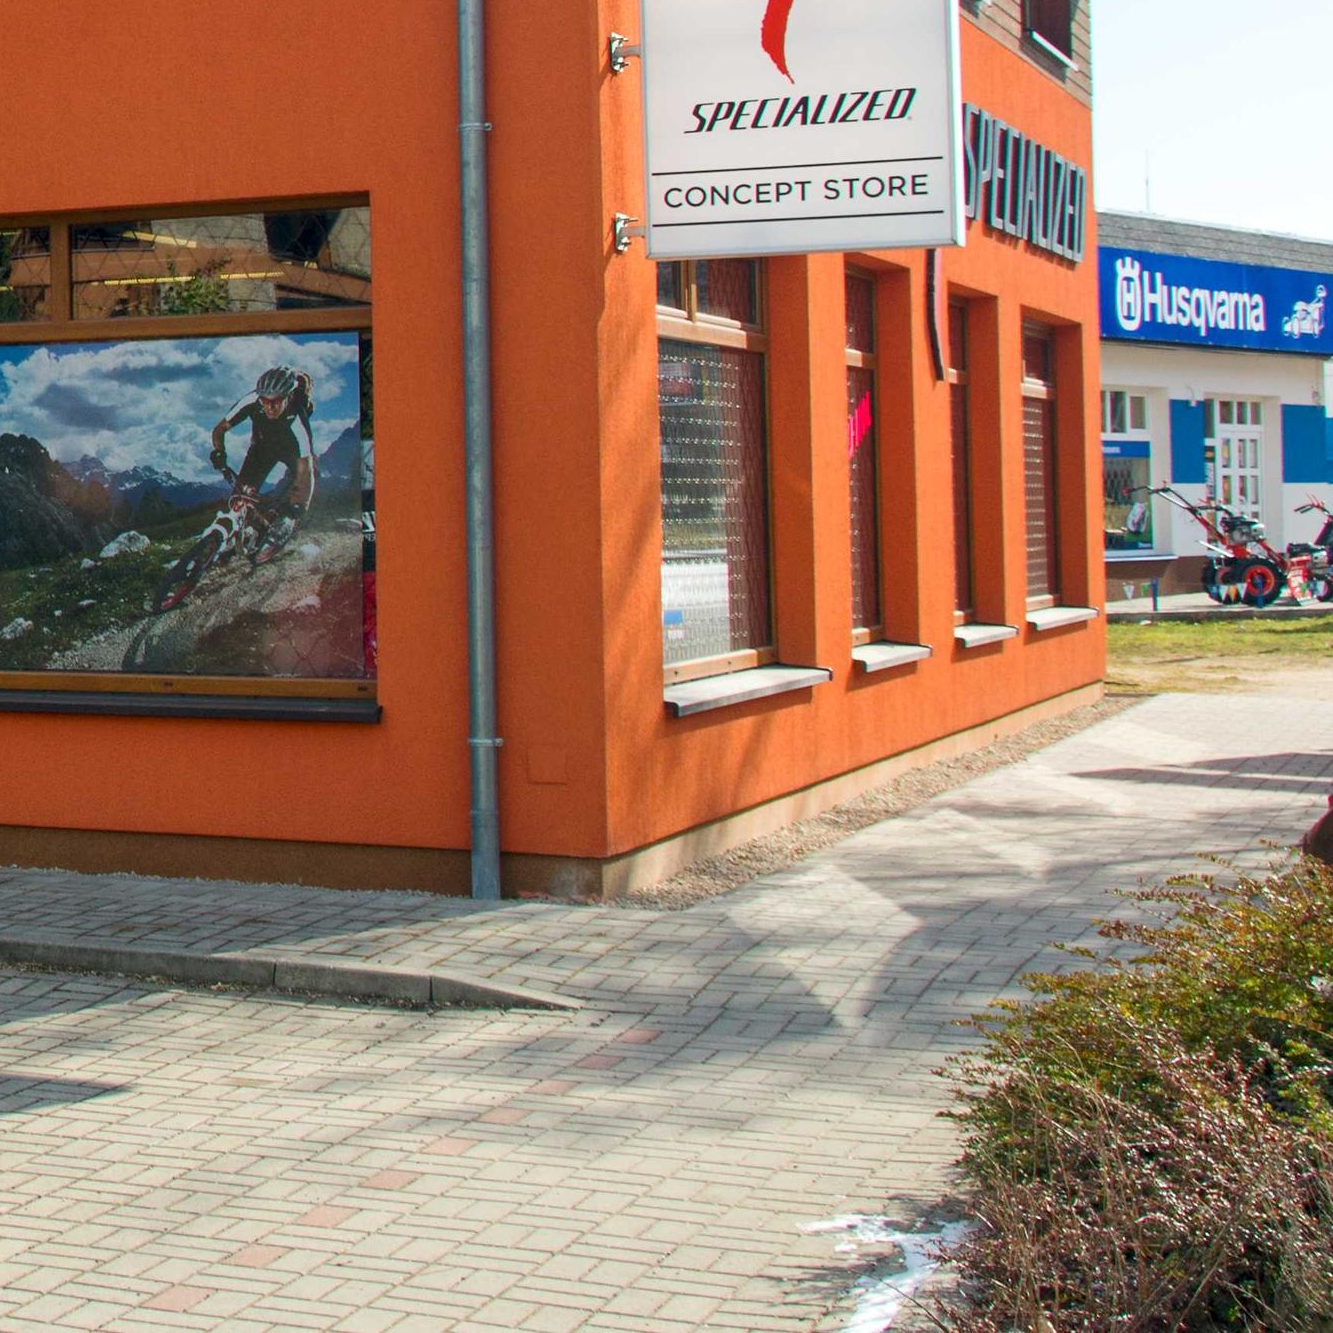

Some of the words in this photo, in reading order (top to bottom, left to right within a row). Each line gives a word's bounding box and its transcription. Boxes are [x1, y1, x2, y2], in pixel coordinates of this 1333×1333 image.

[683, 87, 917, 134] SPECIALIZED
[663, 180, 812, 209] CONCEPT
[824, 173, 929, 200] STORE
[1142, 270, 1267, 337] Husqvarna
